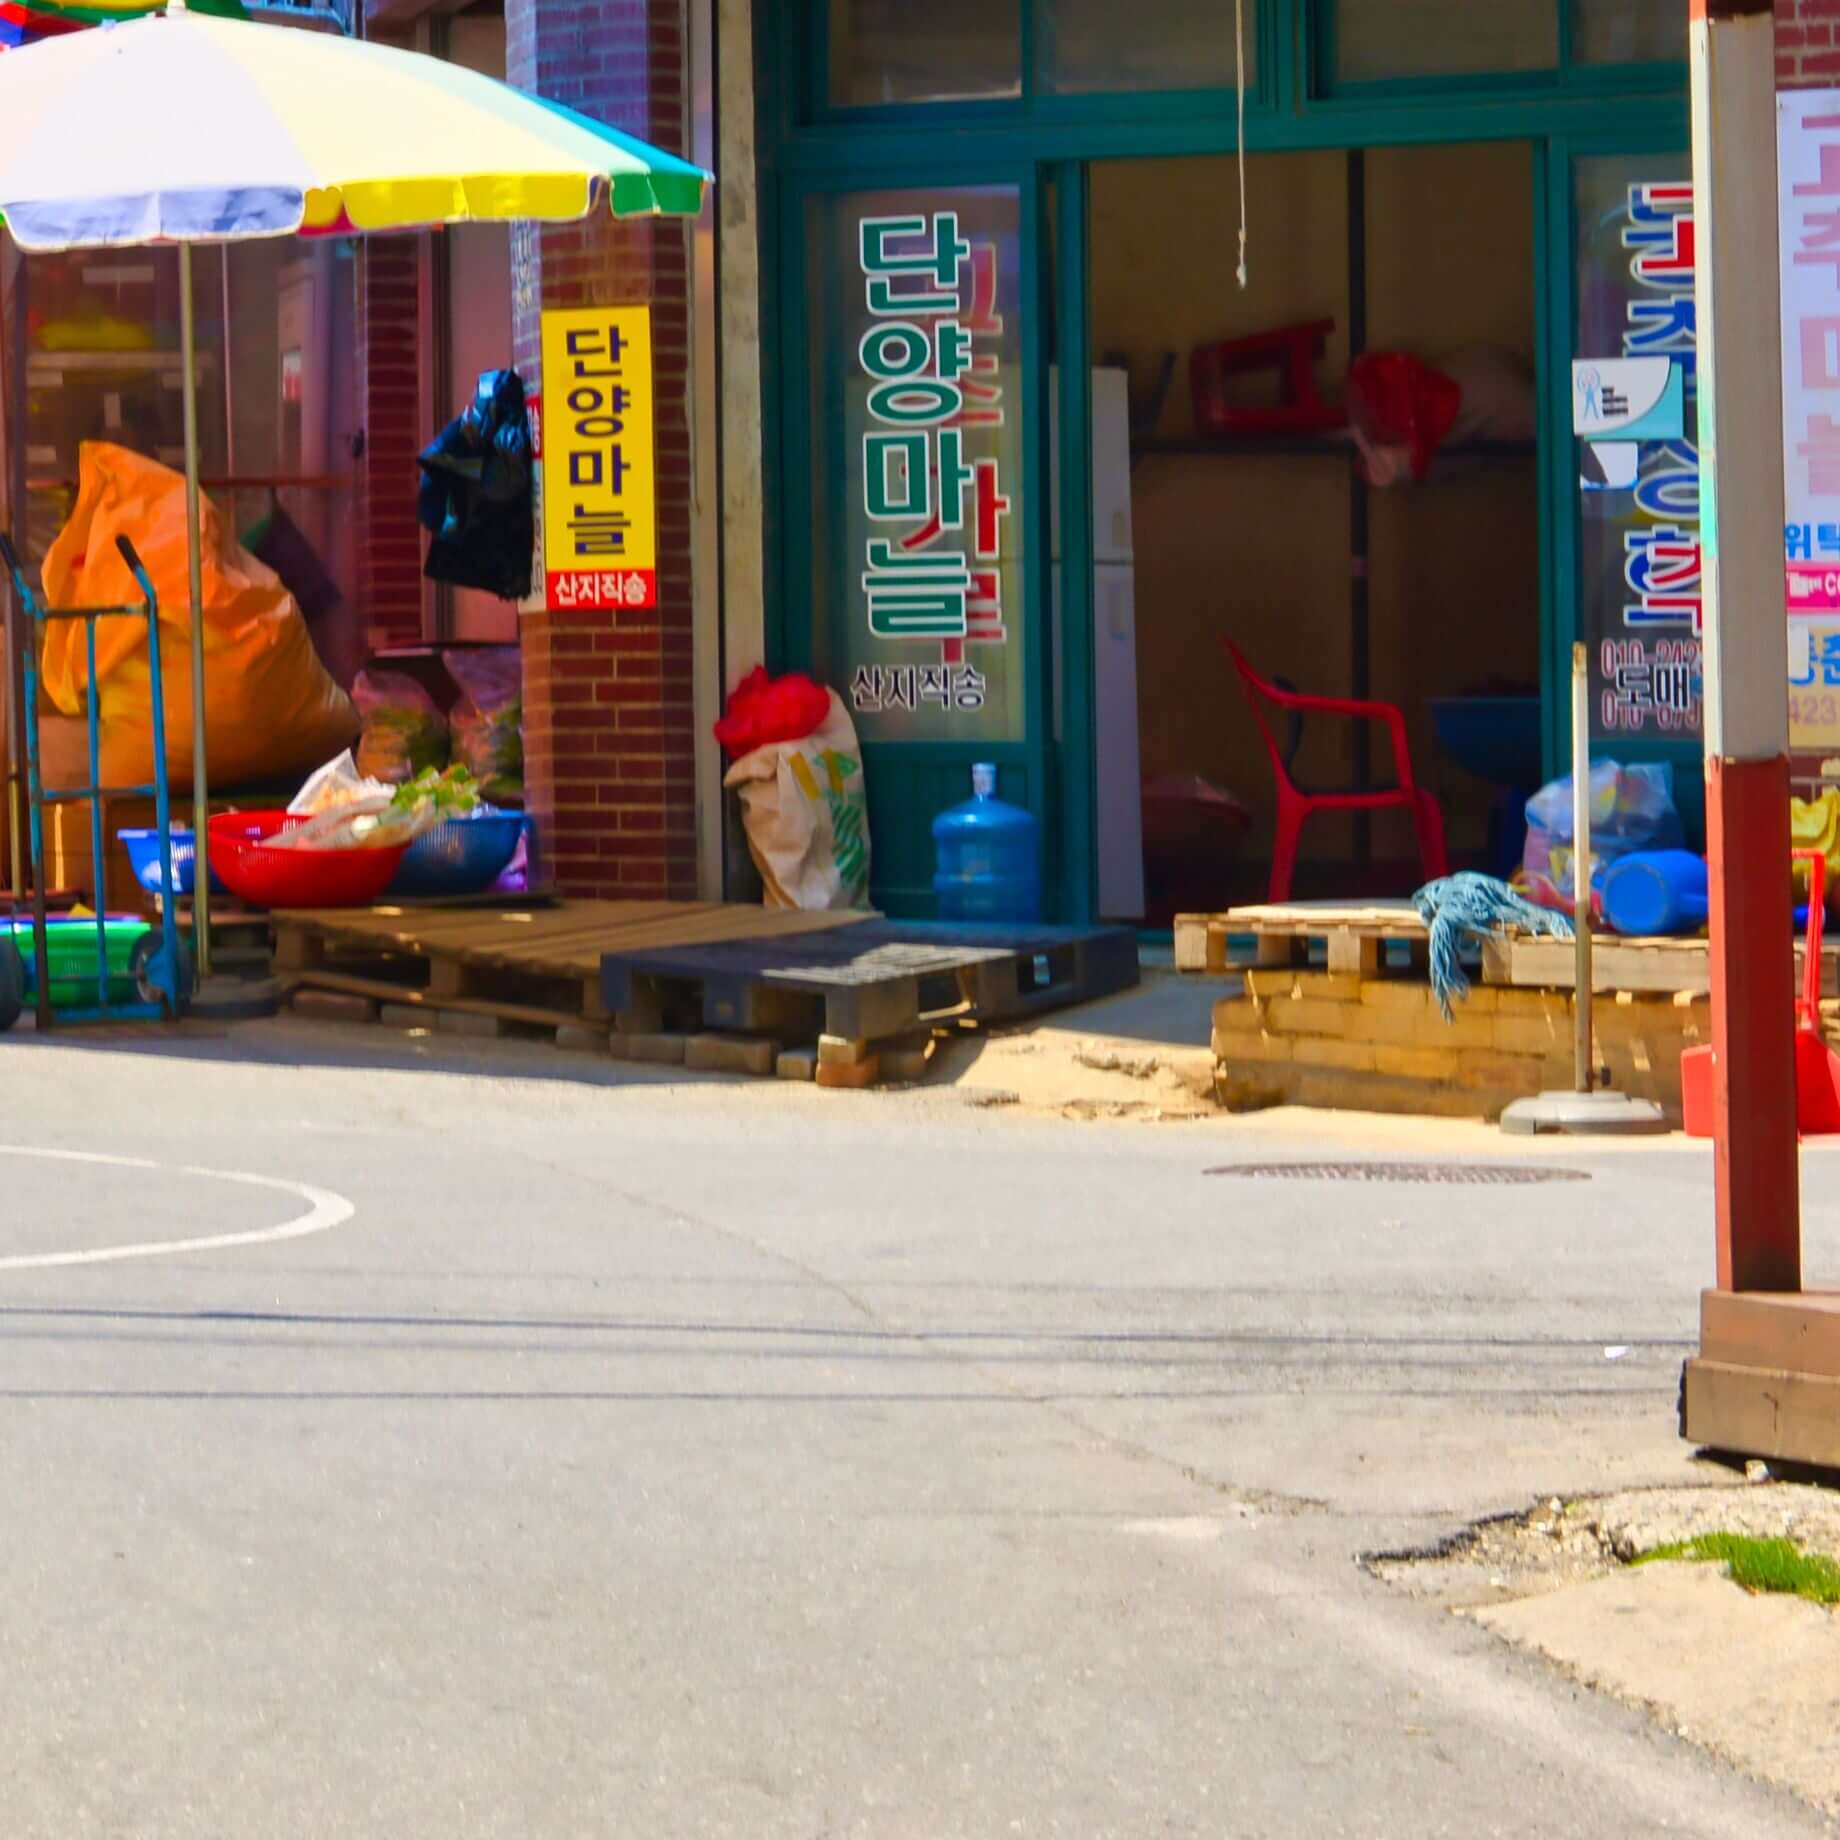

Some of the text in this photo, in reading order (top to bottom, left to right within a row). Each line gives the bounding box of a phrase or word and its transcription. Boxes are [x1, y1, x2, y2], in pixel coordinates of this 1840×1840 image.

[565, 323, 632, 557] 단양마늘
[858, 210, 976, 640] 단양마늘
[554, 571, 648, 607] 산지직송
[849, 663, 987, 713] 산지직송
[1615, 663, 1690, 712] 도매
